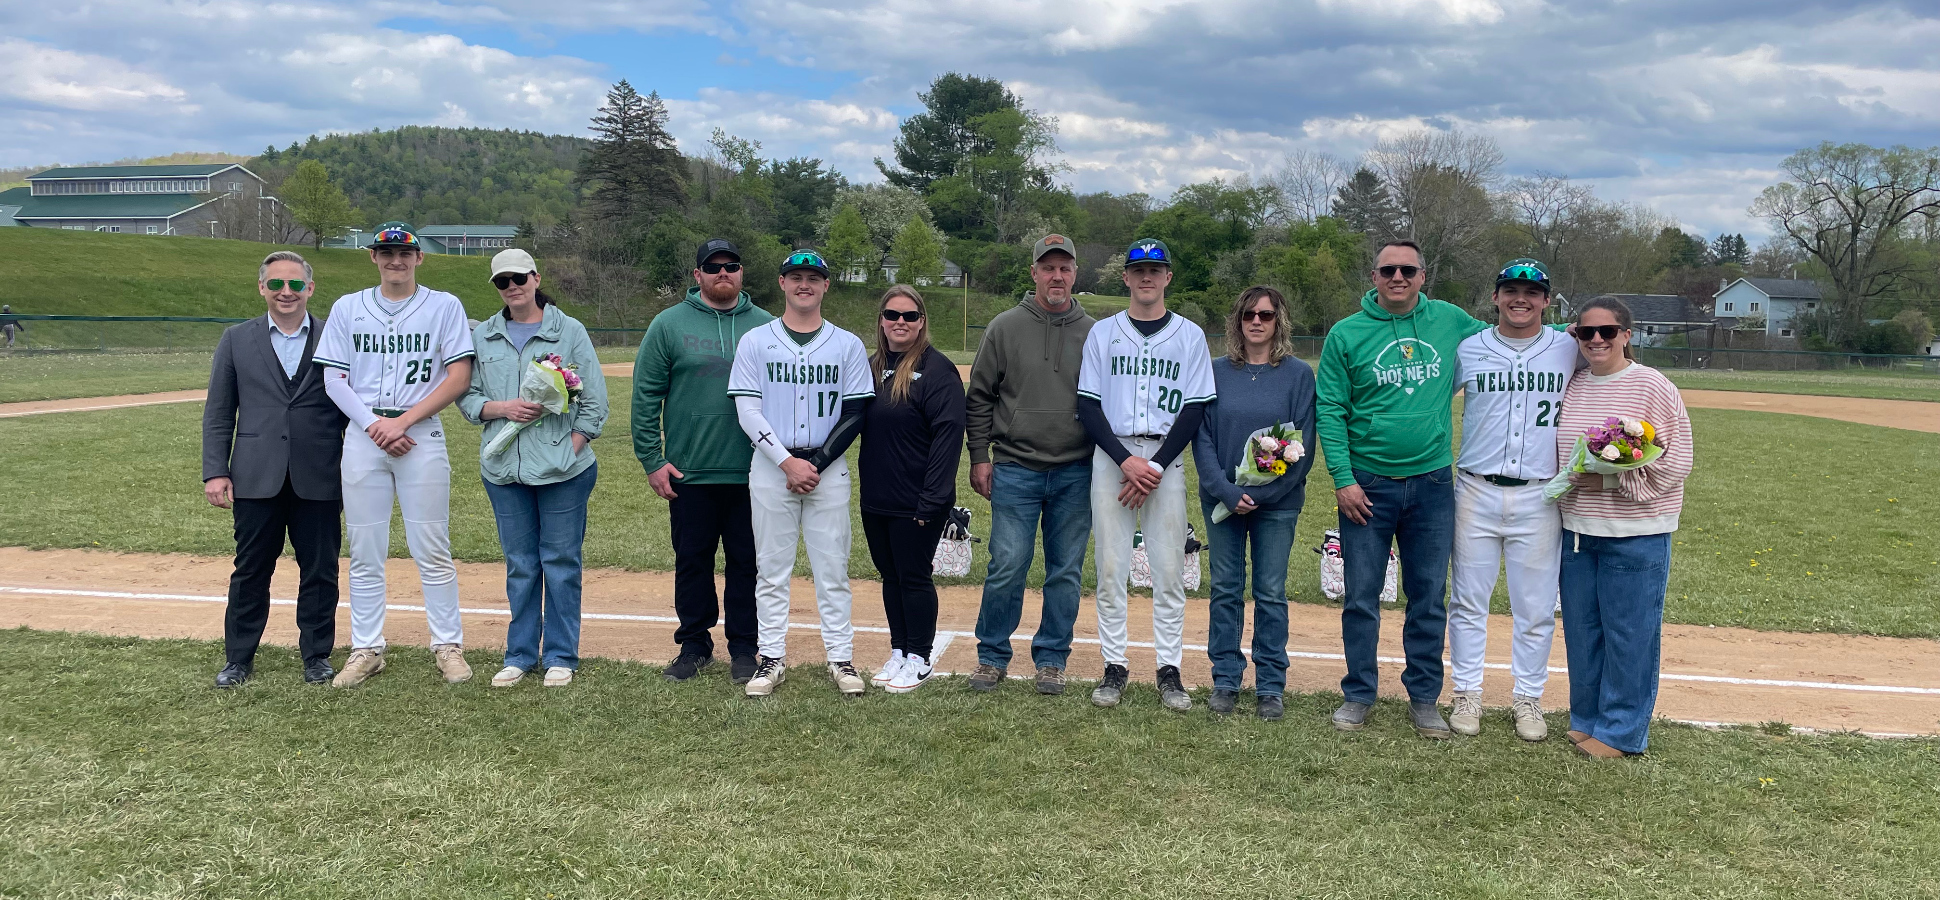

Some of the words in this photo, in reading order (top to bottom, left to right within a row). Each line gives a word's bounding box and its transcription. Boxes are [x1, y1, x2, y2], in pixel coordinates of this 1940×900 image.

[352, 333, 430, 354] WELLSBORO
[405, 358, 433, 385] 25
[766, 362, 839, 385] WELLSBORO
[1476, 370, 1564, 393] WELLSBORO
[817, 390, 839, 417] 17
[1157, 385, 1183, 414] 20
[1535, 399, 1564, 427] 22
